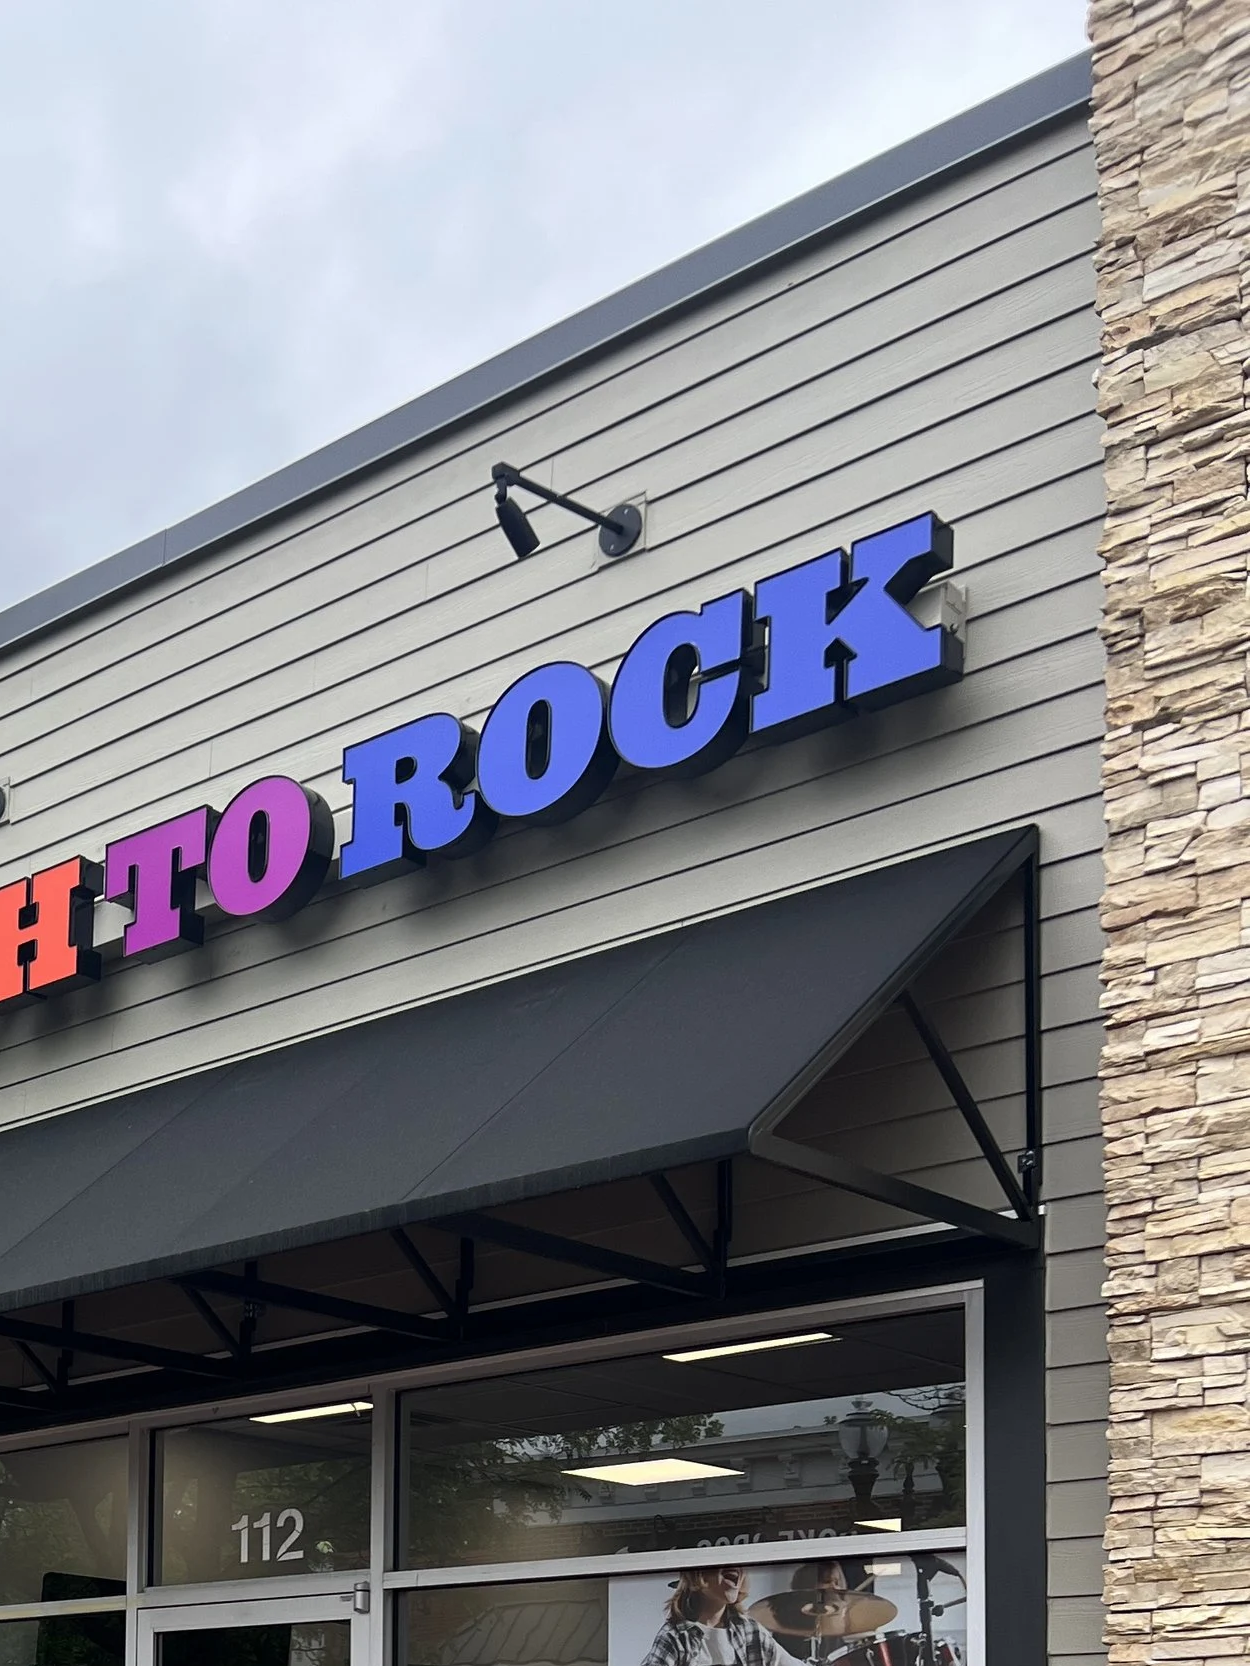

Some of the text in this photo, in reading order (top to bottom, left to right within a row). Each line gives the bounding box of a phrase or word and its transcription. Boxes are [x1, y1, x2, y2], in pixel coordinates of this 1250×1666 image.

[103, 774, 313, 958] TO
[338, 510, 950, 881] ROCK
[231, 1508, 304, 1563] 112
